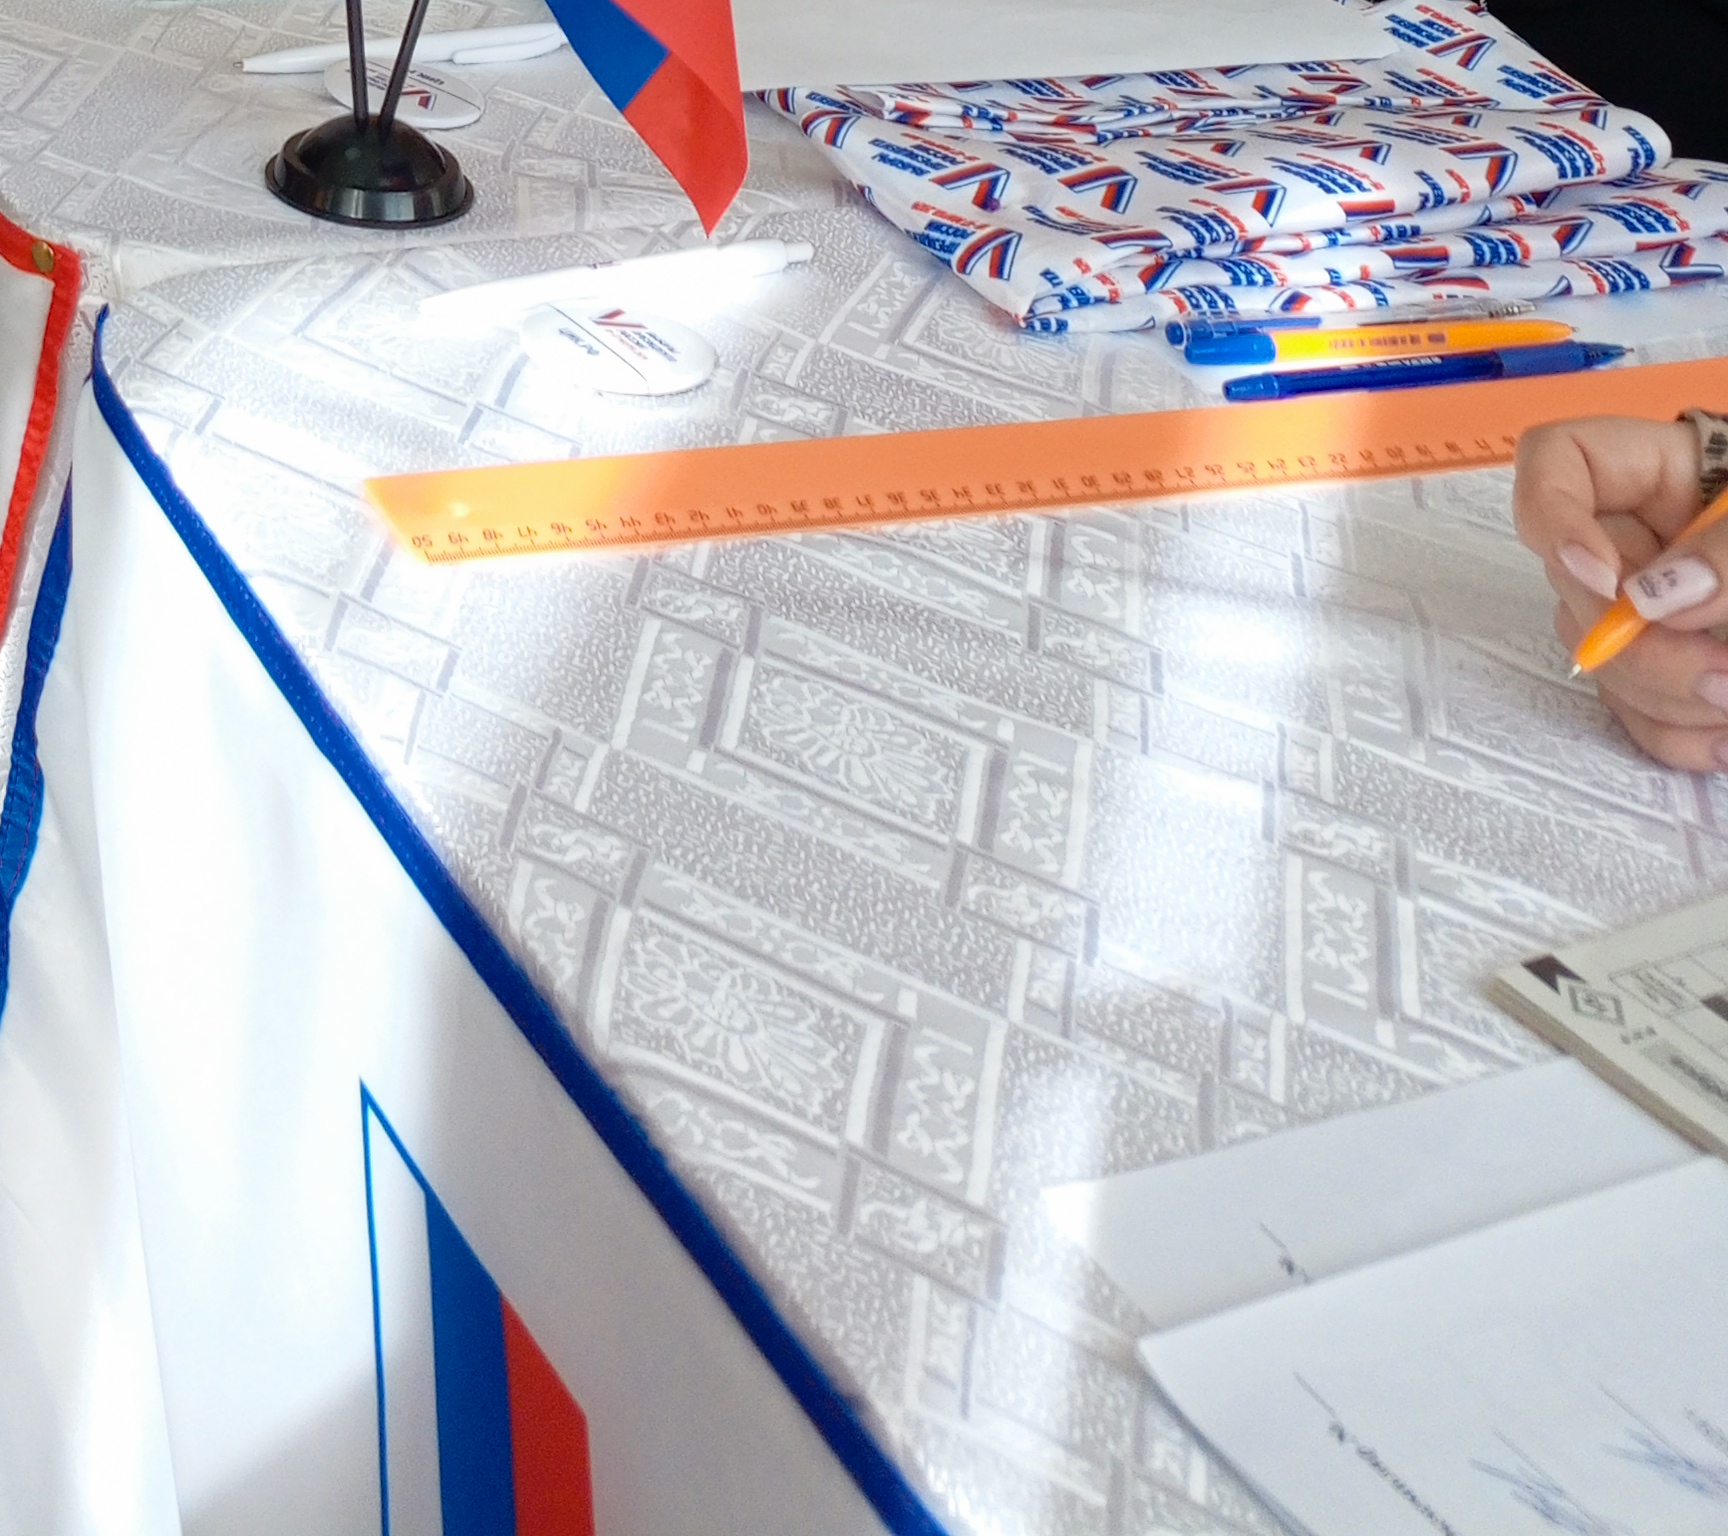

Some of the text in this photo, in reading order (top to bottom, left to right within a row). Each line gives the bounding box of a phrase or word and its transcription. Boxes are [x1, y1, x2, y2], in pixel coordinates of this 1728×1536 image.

[1328, 453, 1347, 465] 22
[1358, 449, 1373, 462] 21
[1384, 446, 1404, 459] 20
[1266, 457, 1287, 471] 24
[1297, 455, 1316, 468] 23
[1174, 466, 1195, 480] 27
[1204, 463, 1224, 477] 26
[1052, 477, 1069, 490] 31
[1080, 474, 1101, 488] 30
[919, 488, 938, 502] 35
[952, 486, 972, 499] 34
[984, 482, 1004, 496] 33
[823, 497, 843, 510] 38
[855, 494, 874, 507] 37
[886, 491, 907, 505] 36
[756, 503, 778, 516] 40
[790, 499, 810, 512] 39
[654, 512, 676, 526] 43
[688, 509, 710, 522] 42
[726, 506, 742, 519] 41
[585, 518, 608, 532] 45
[620, 516, 641, 528] 44
[482, 528, 503, 542] 48
[517, 526, 538, 538] 47
[550, 522, 572, 536] 46
[412, 534, 433, 548] 50
[448, 530, 468, 544] 49
